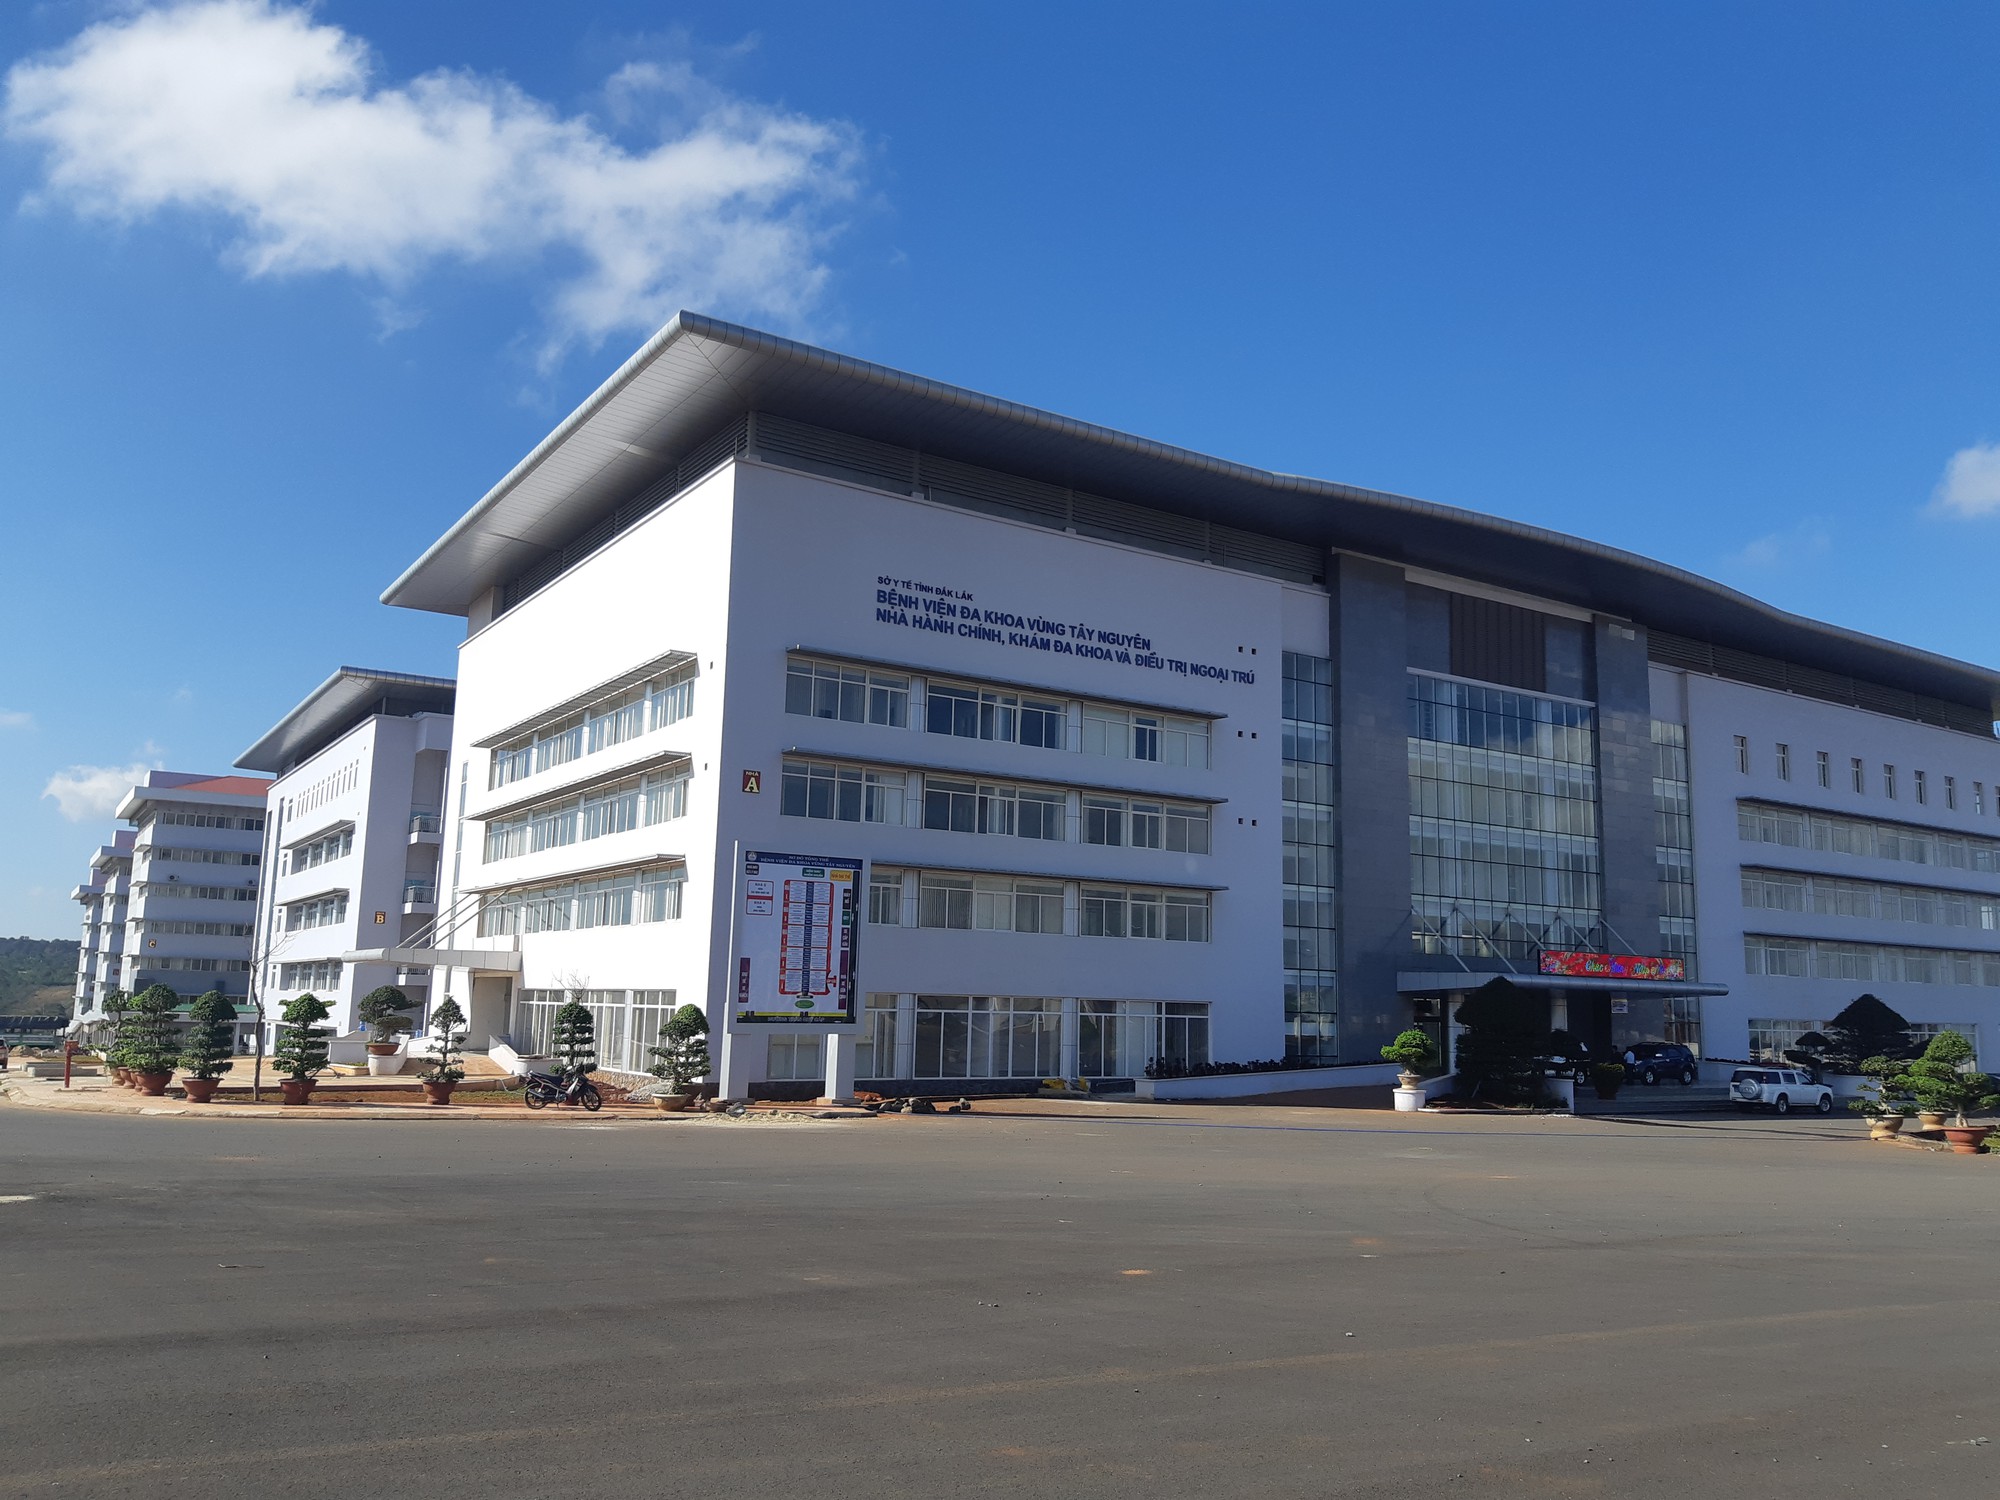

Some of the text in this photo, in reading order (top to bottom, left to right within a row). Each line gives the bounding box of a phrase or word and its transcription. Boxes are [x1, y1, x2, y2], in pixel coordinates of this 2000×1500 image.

[877, 576, 892, 586] SỞ
[893, 579, 900, 587] Y
[900, 579, 913, 590] TẾ
[914, 581, 934, 594] TỈNH
[877, 588, 1151, 651] BỆNH VIỆN ĐA KHOA VÙNG TÂY NGUYÊN
[876, 607, 1256, 685] NHÀ HÀNH CHÍNH, KHÁM ĐA KHOA VÀ ĐIỀU TRỊ NGOẠI TRÚ
[744, 776, 760, 793] A
[376, 914, 385, 924] B
